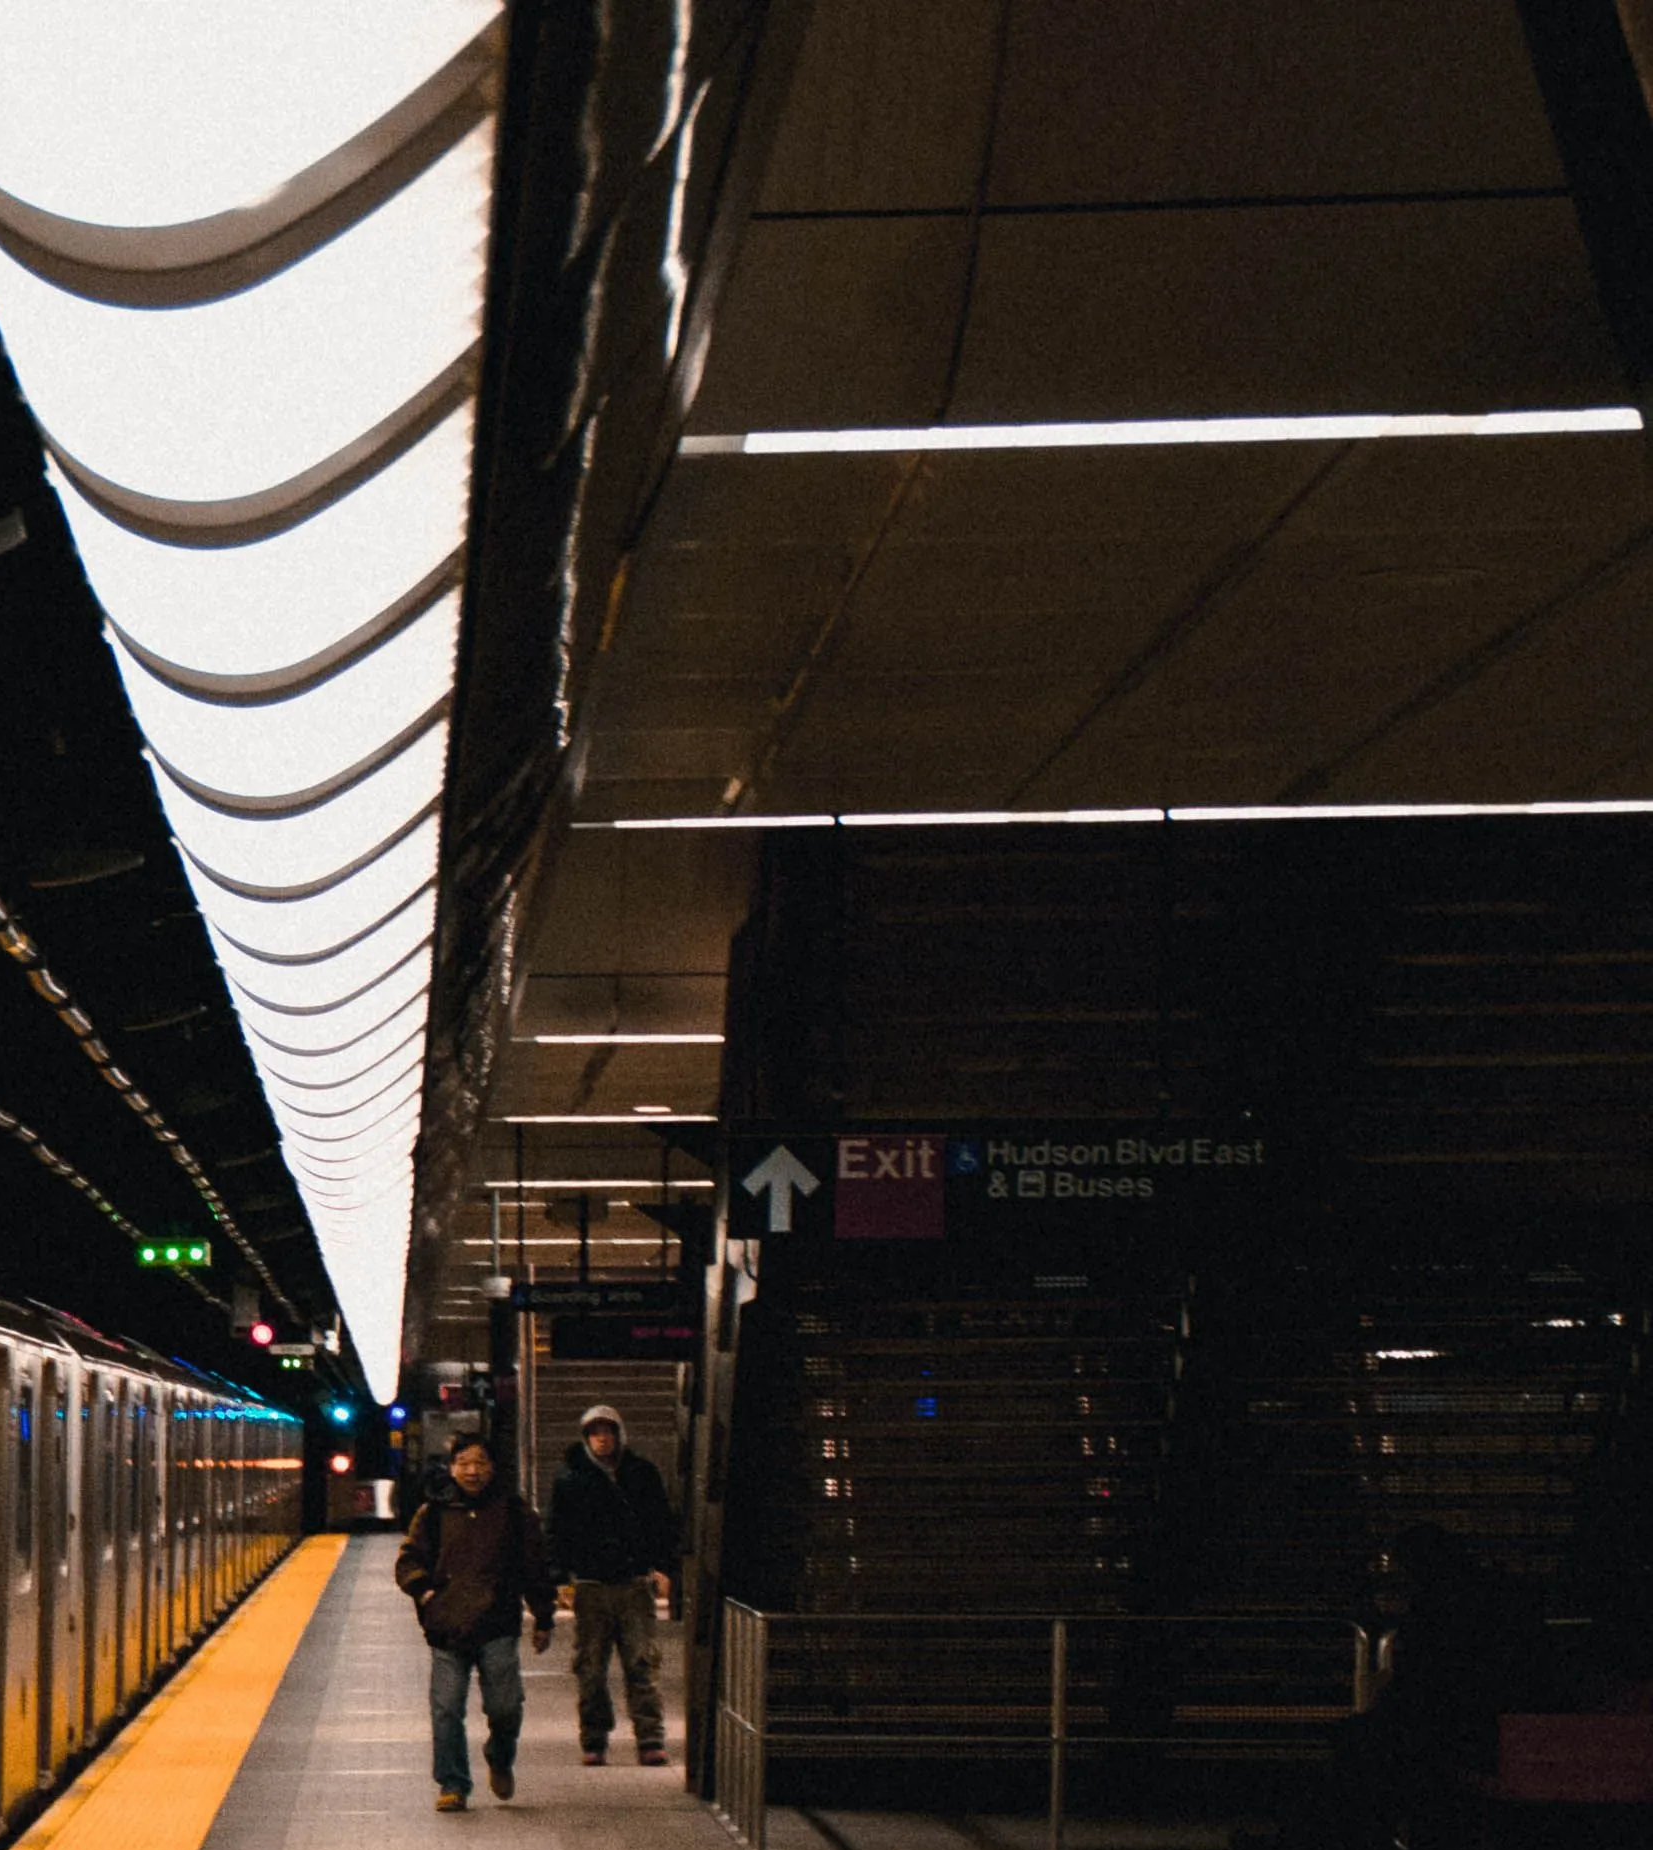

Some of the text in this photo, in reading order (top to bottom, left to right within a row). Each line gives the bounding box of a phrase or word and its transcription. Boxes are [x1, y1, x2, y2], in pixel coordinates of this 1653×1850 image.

[837, 1139, 936, 1180] Exit
[987, 1140, 1265, 1166] Hudson Blvd East
[987, 1172, 1155, 1199] & Buses
